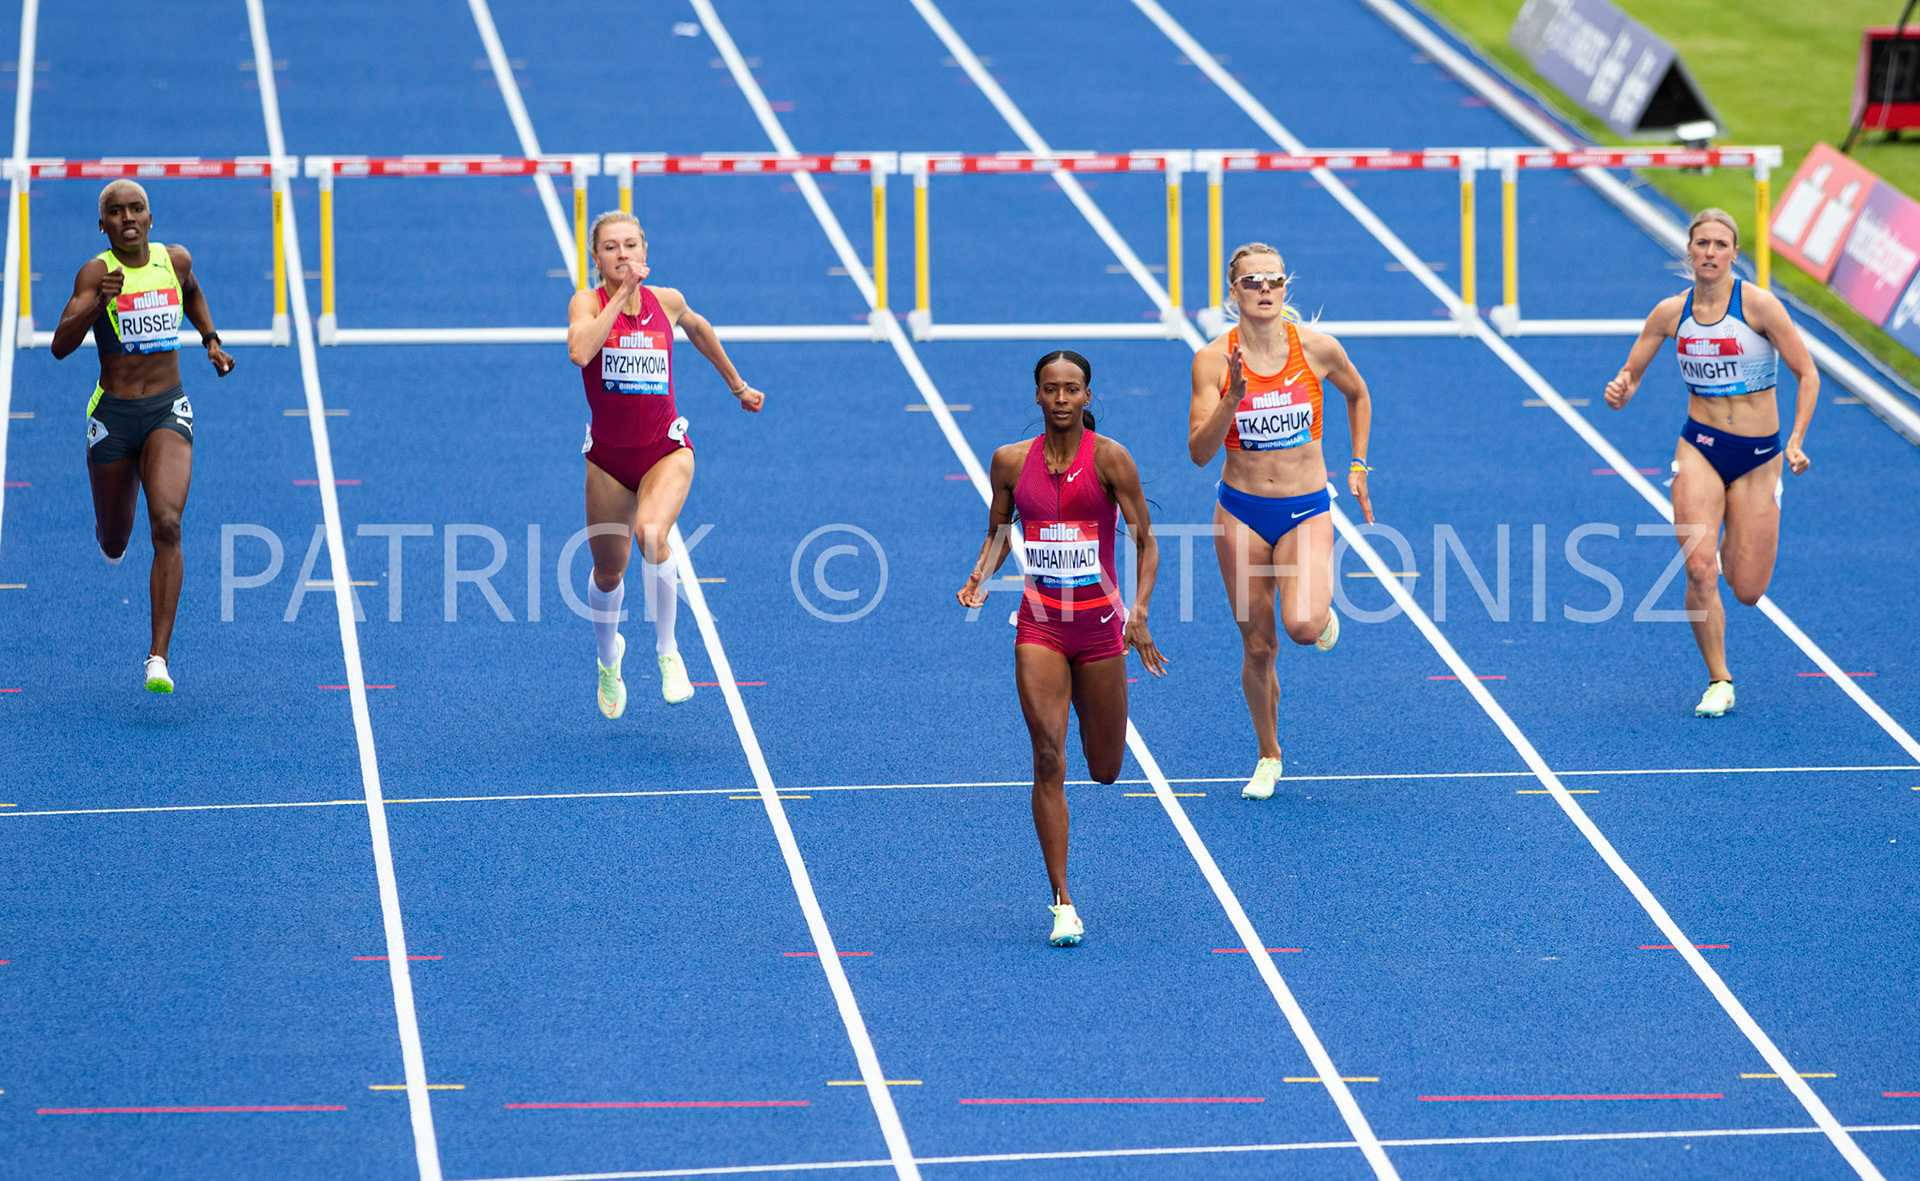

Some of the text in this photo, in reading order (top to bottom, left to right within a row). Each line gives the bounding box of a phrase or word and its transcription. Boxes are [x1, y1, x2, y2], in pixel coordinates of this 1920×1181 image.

[134, 290, 168, 310] müller
[620, 331, 654, 348] müller
[1686, 340, 1721, 356] müller
[604, 354, 667, 374] RYZHYKOVA
[1680, 360, 1738, 379] KNIGHT
[619, 382, 663, 391] BIRMINGHAM
[1252, 390, 1292, 410] müller
[1239, 410, 1311, 434] TKACHUK
[1040, 523, 1080, 541] müller
[1026, 547, 1096, 569] MUHAMMAD
